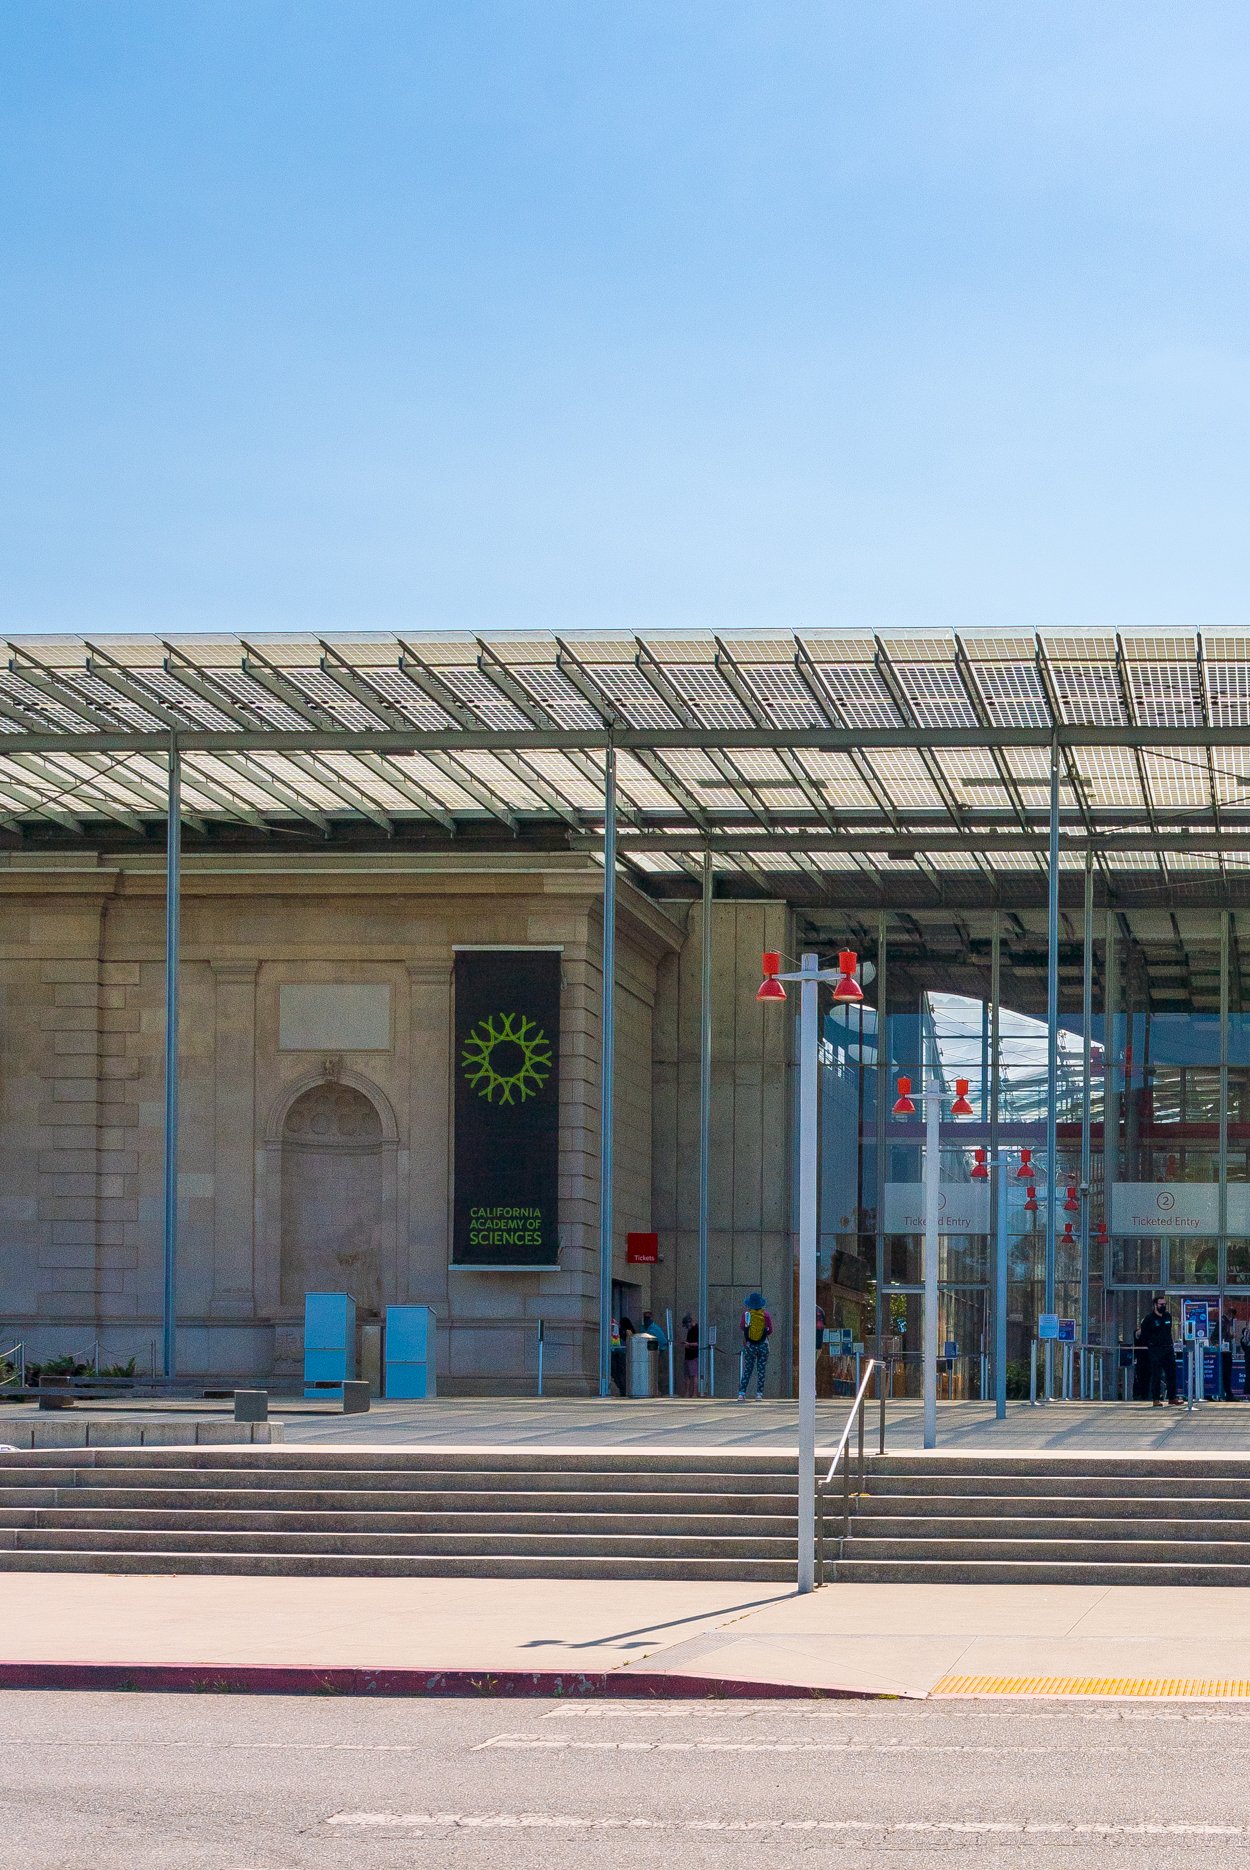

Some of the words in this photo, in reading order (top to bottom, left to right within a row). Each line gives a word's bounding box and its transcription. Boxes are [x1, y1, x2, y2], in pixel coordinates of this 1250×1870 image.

[470, 1207, 542, 1217] CALIFORNIA
[470, 1219, 525, 1229] ACADEMY
[526, 1219, 542, 1229] OF
[904, 1216, 943, 1226] Ticked
[946, 1216, 971, 1228] Entry
[1132, 1216, 1172, 1226] Ticketed
[1175, 1216, 1201, 1228] Entry
[470, 1231, 542, 1245] SCIENCES
